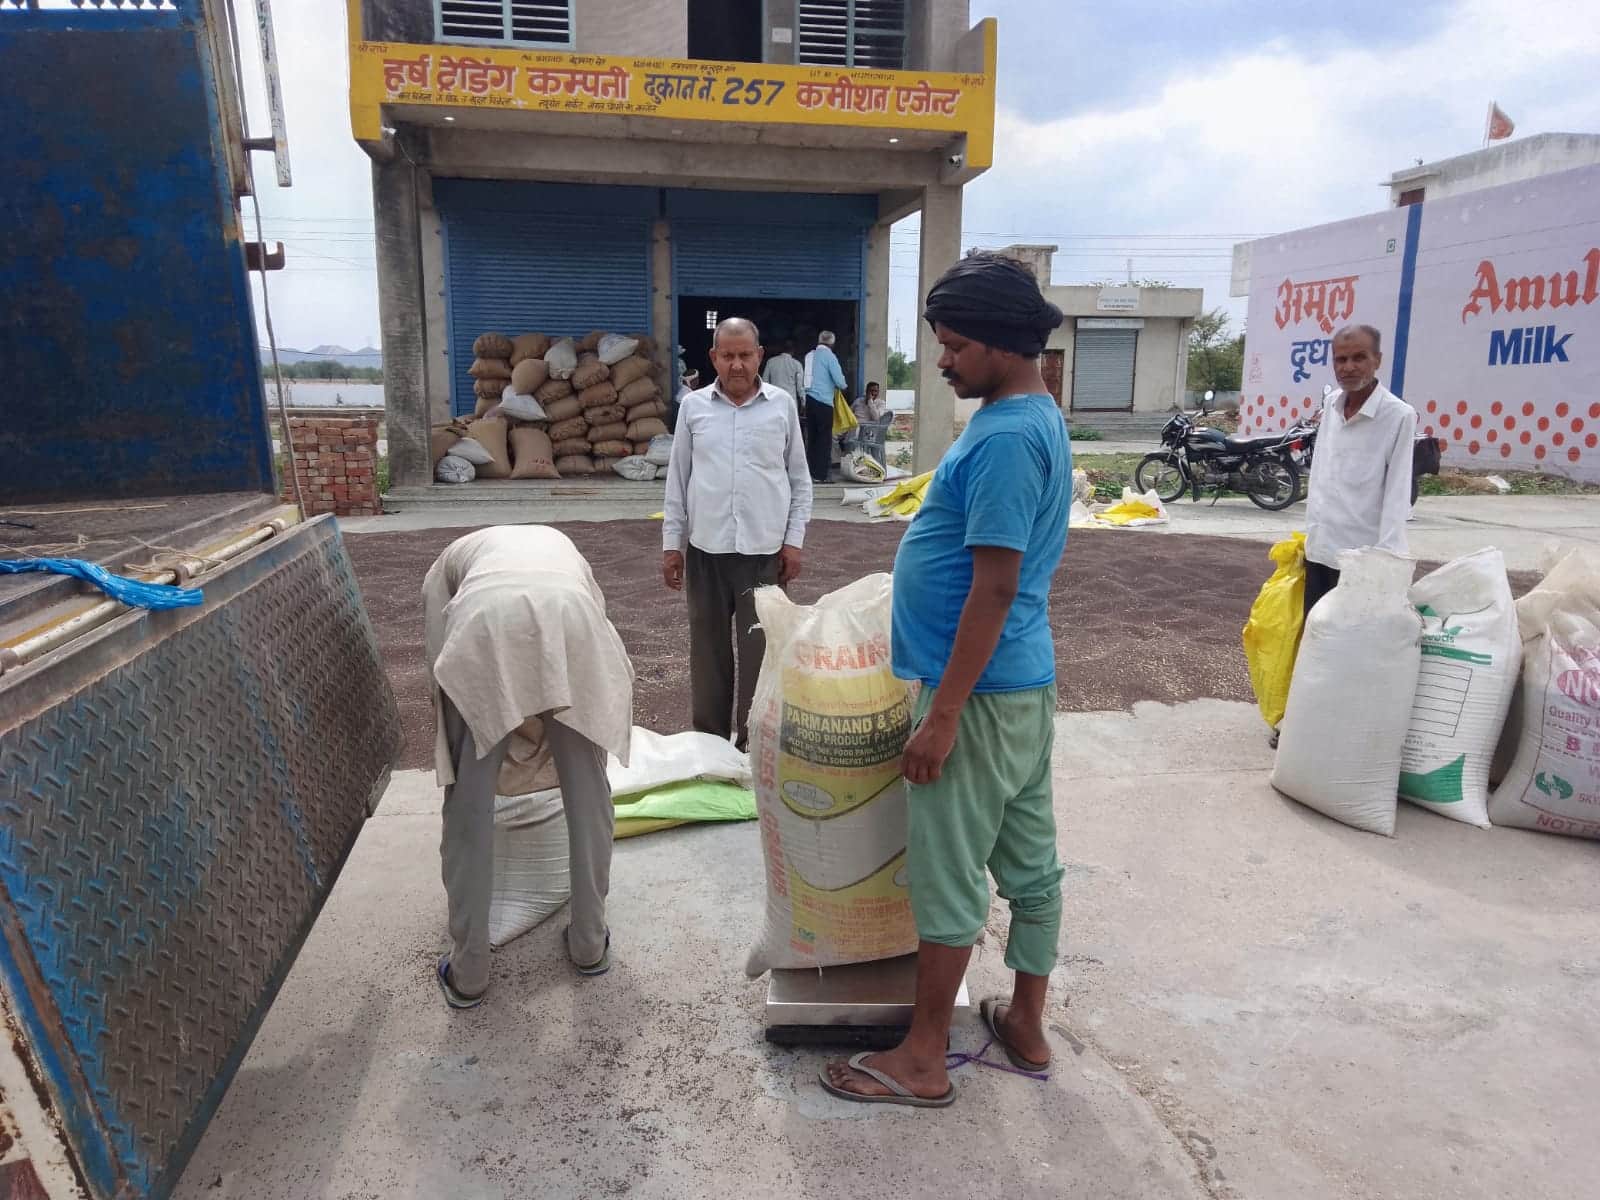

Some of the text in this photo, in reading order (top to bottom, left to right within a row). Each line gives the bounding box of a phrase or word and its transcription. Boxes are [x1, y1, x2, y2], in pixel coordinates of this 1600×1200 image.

[383, 54, 432, 92] हर्ष
[437, 55, 517, 95] ट्रेडिंग
[526, 65, 630, 99] कम्पनी
[722, 77, 785, 106] 257
[796, 75, 890, 113] कमीशन
[895, 80, 960, 115] एजेन्ट
[1275, 274, 1359, 334] अमूल
[1462, 247, 1600, 325] Amul
[1290, 338, 1334, 383] दूध
[1488, 325, 1574, 366] Milk
[785, 703, 874, 735] PARMANAND
[877, 713, 887, 731] &
[797, 726, 821, 743] FOOD
[824, 732, 871, 747] PRODUCT
[1549, 705, 1592, 729] Quality
[1536, 814, 1577, 834] NOT
